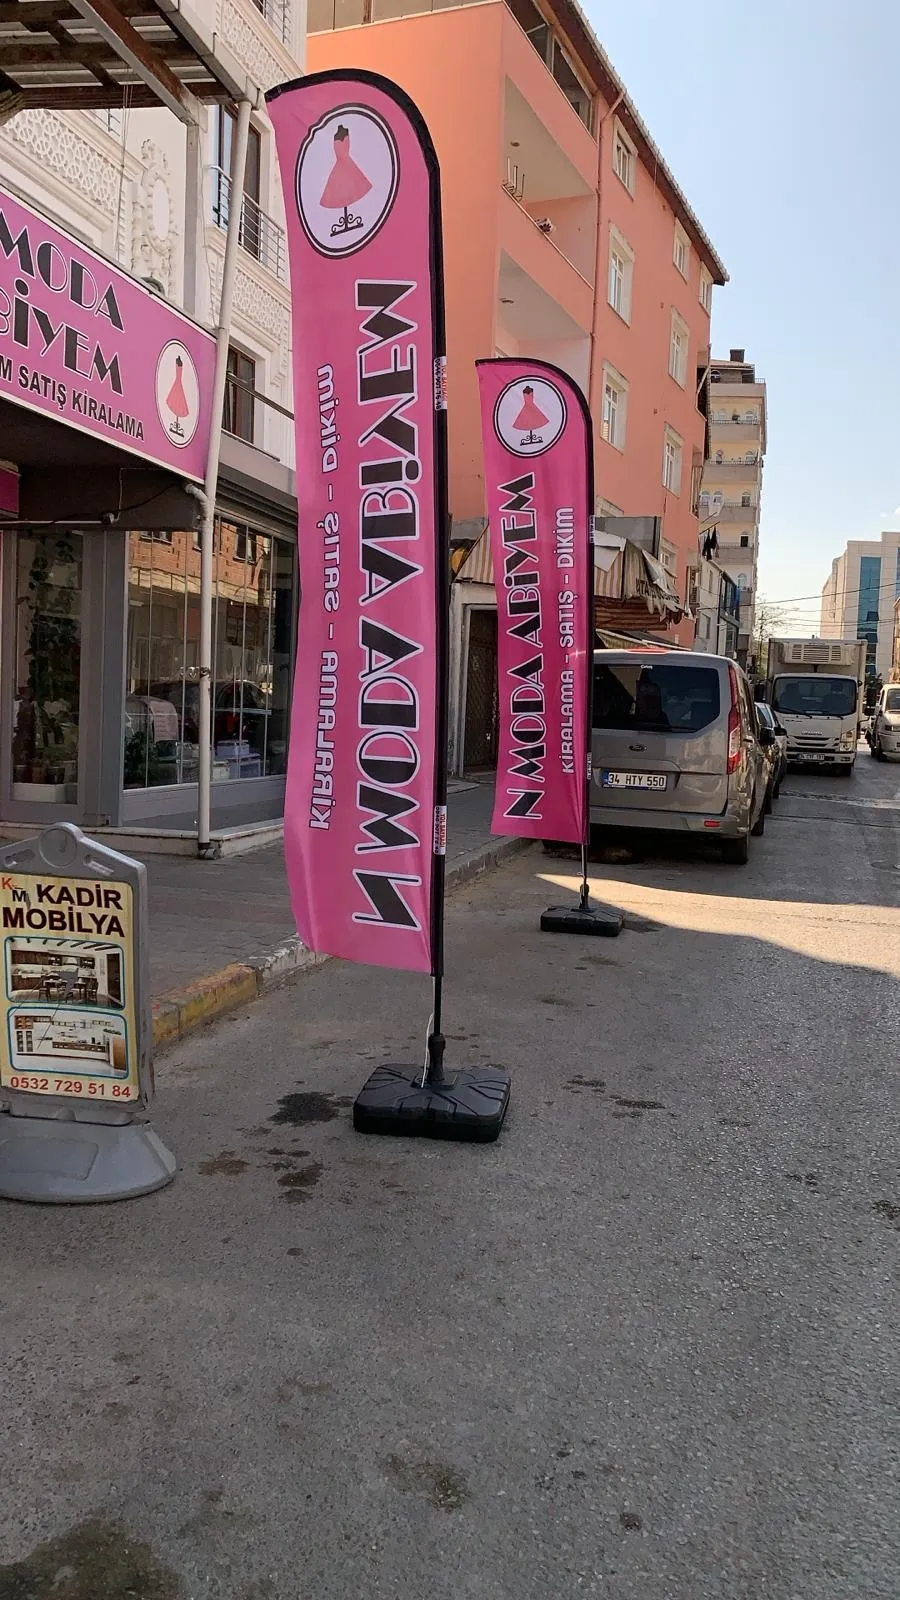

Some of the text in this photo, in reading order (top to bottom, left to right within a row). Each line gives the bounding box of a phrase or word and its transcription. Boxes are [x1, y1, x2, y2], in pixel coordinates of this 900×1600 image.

[18, 364, 67, 413] SATIŞ
[71, 386, 145, 442] KİRALAMA
[497, 471, 544, 648] ABİYEM
[553, 507, 575, 569] DİKİM
[558, 590, 579, 648] SATIŞ
[507, 652, 547, 782] MODA
[559, 669, 575, 774] KİRALAMA
[608, 773, 665, 787] 34 HTY 550
[2, 905, 125, 938] MOBİLYA
[36, 883, 123, 911] KADİR
[10, 1076, 131, 1098] 0532 729 51 84
